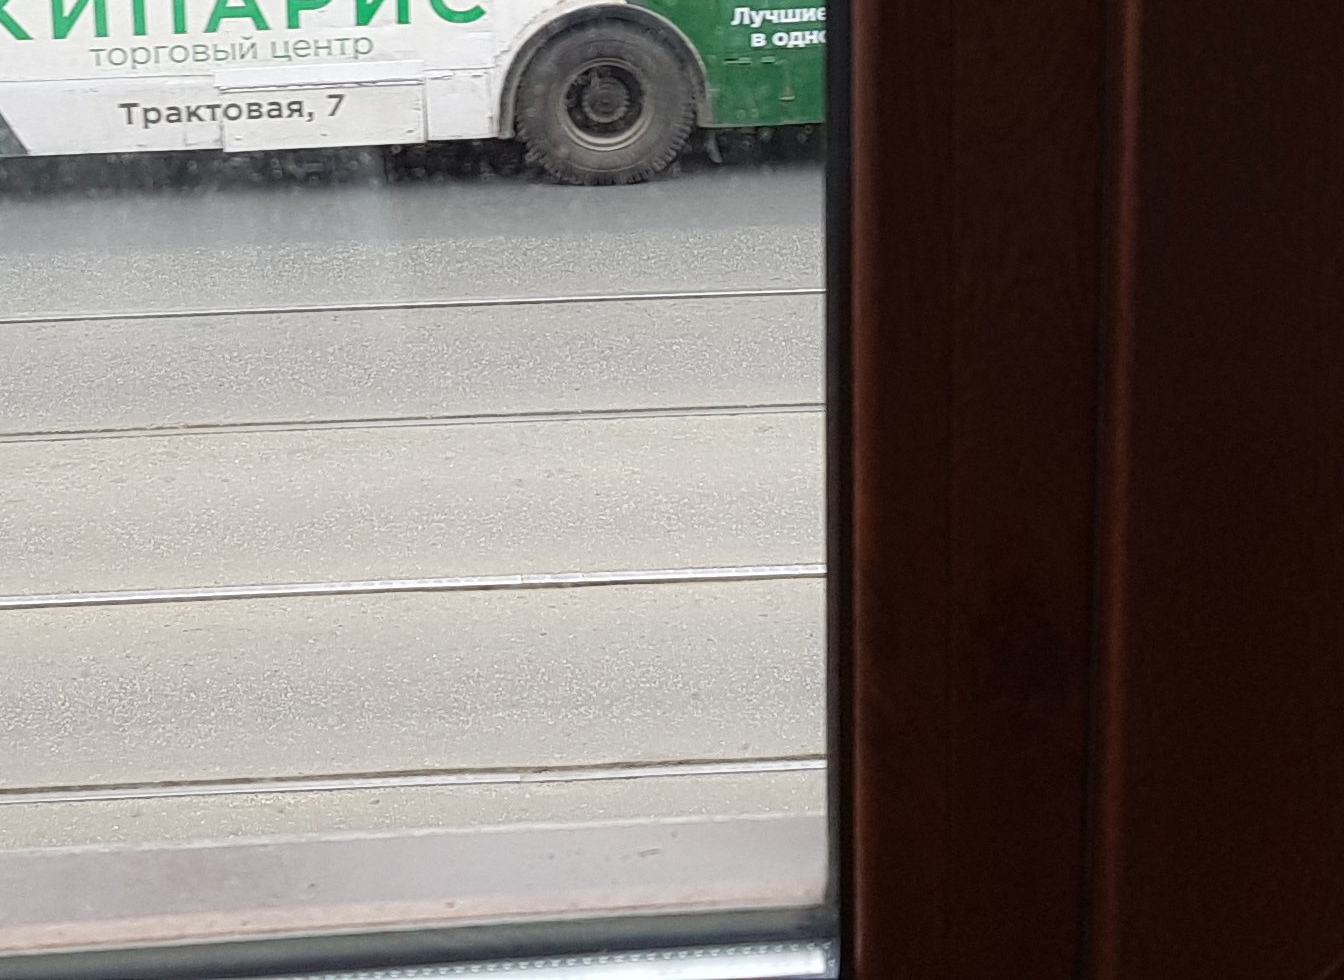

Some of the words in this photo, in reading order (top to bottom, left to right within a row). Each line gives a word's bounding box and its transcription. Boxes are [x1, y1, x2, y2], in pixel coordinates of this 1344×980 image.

[88, 36, 258, 70] торговый
[270, 36, 374, 62] центр
[750, 32, 767, 48] в
[117, 98, 315, 130] Трактовая,
[325, 93, 346, 118] 7
